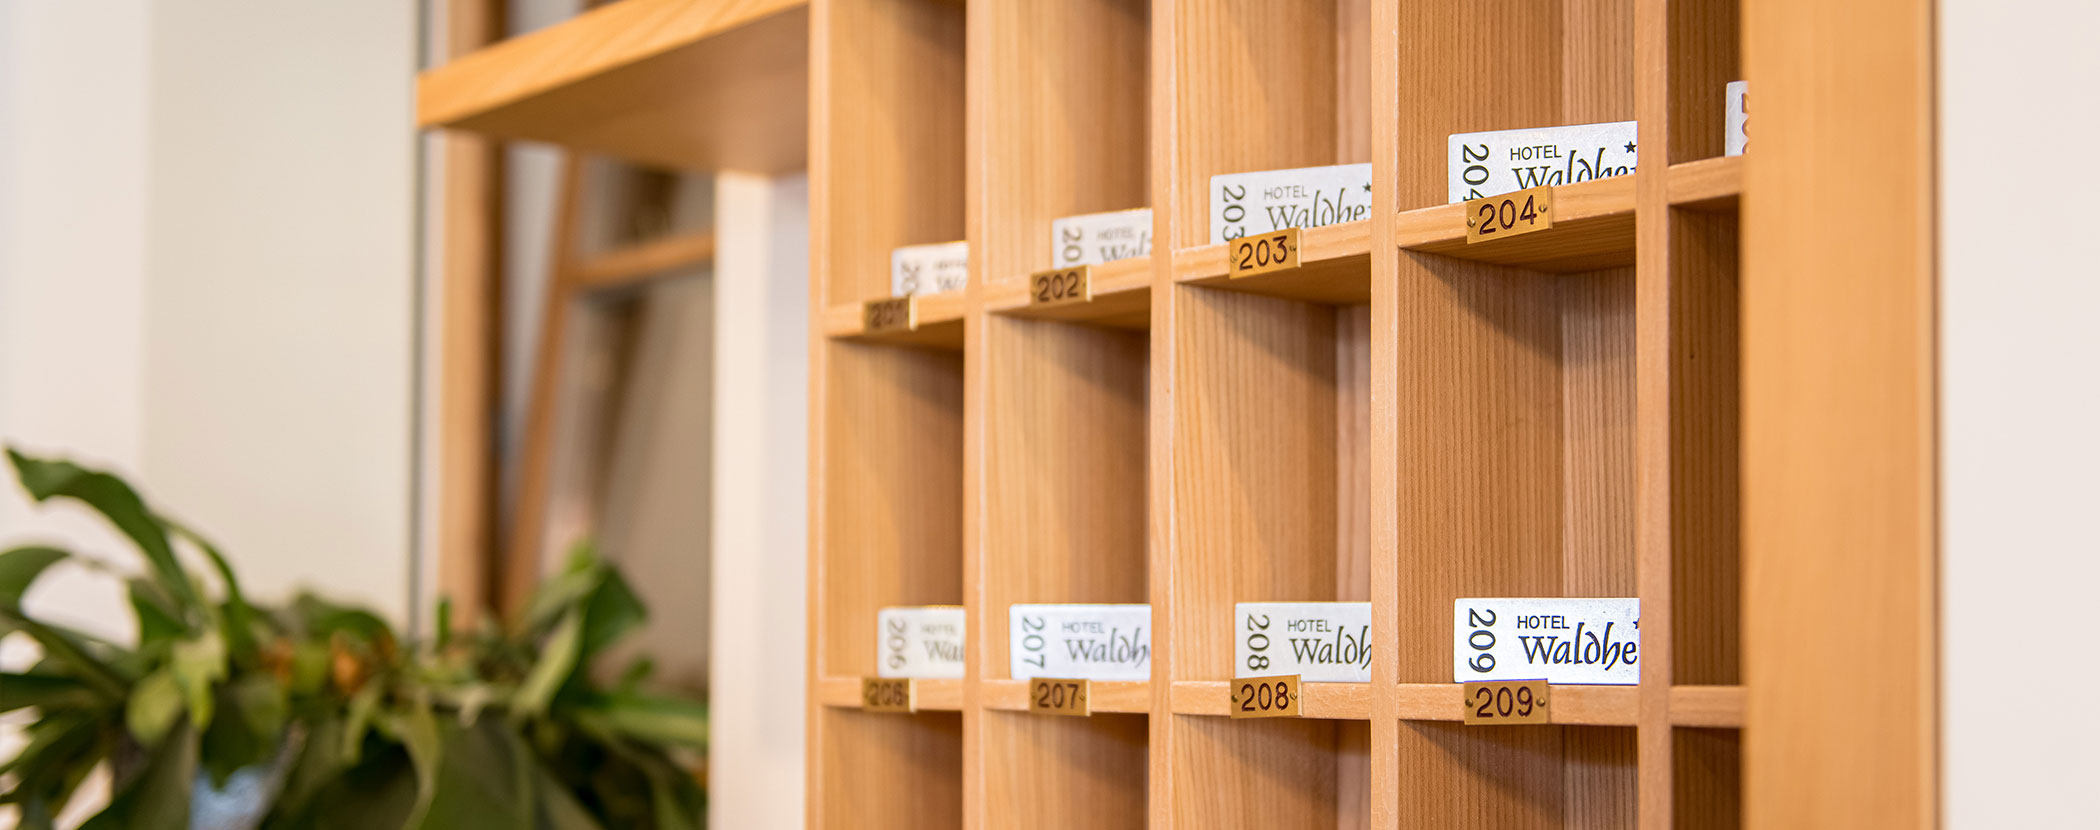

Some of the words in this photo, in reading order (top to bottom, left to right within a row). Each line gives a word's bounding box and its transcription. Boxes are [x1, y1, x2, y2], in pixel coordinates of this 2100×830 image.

[1510, 145, 1562, 161] HOTEL
[1264, 185, 1309, 200] HOTEL
[1265, 187, 1371, 231] Waldhe
[1223, 184, 1246, 242] 203
[1478, 194, 1538, 235] 204
[1239, 235, 1288, 271] 203
[1037, 271, 1080, 302] 202
[1062, 622, 1105, 634] HOTEL
[1287, 619, 1332, 632] HOTEL
[1517, 616, 1570, 629] HOTEL
[1022, 615, 1045, 669] 207
[1064, 627, 1150, 669] Waldh
[1247, 613, 1270, 671] 208
[1289, 625, 1371, 670] Waldh
[1468, 608, 1496, 673] 209
[1037, 682, 1079, 709] 207
[1241, 681, 1289, 711] 208
[1475, 686, 1533, 718] 209
